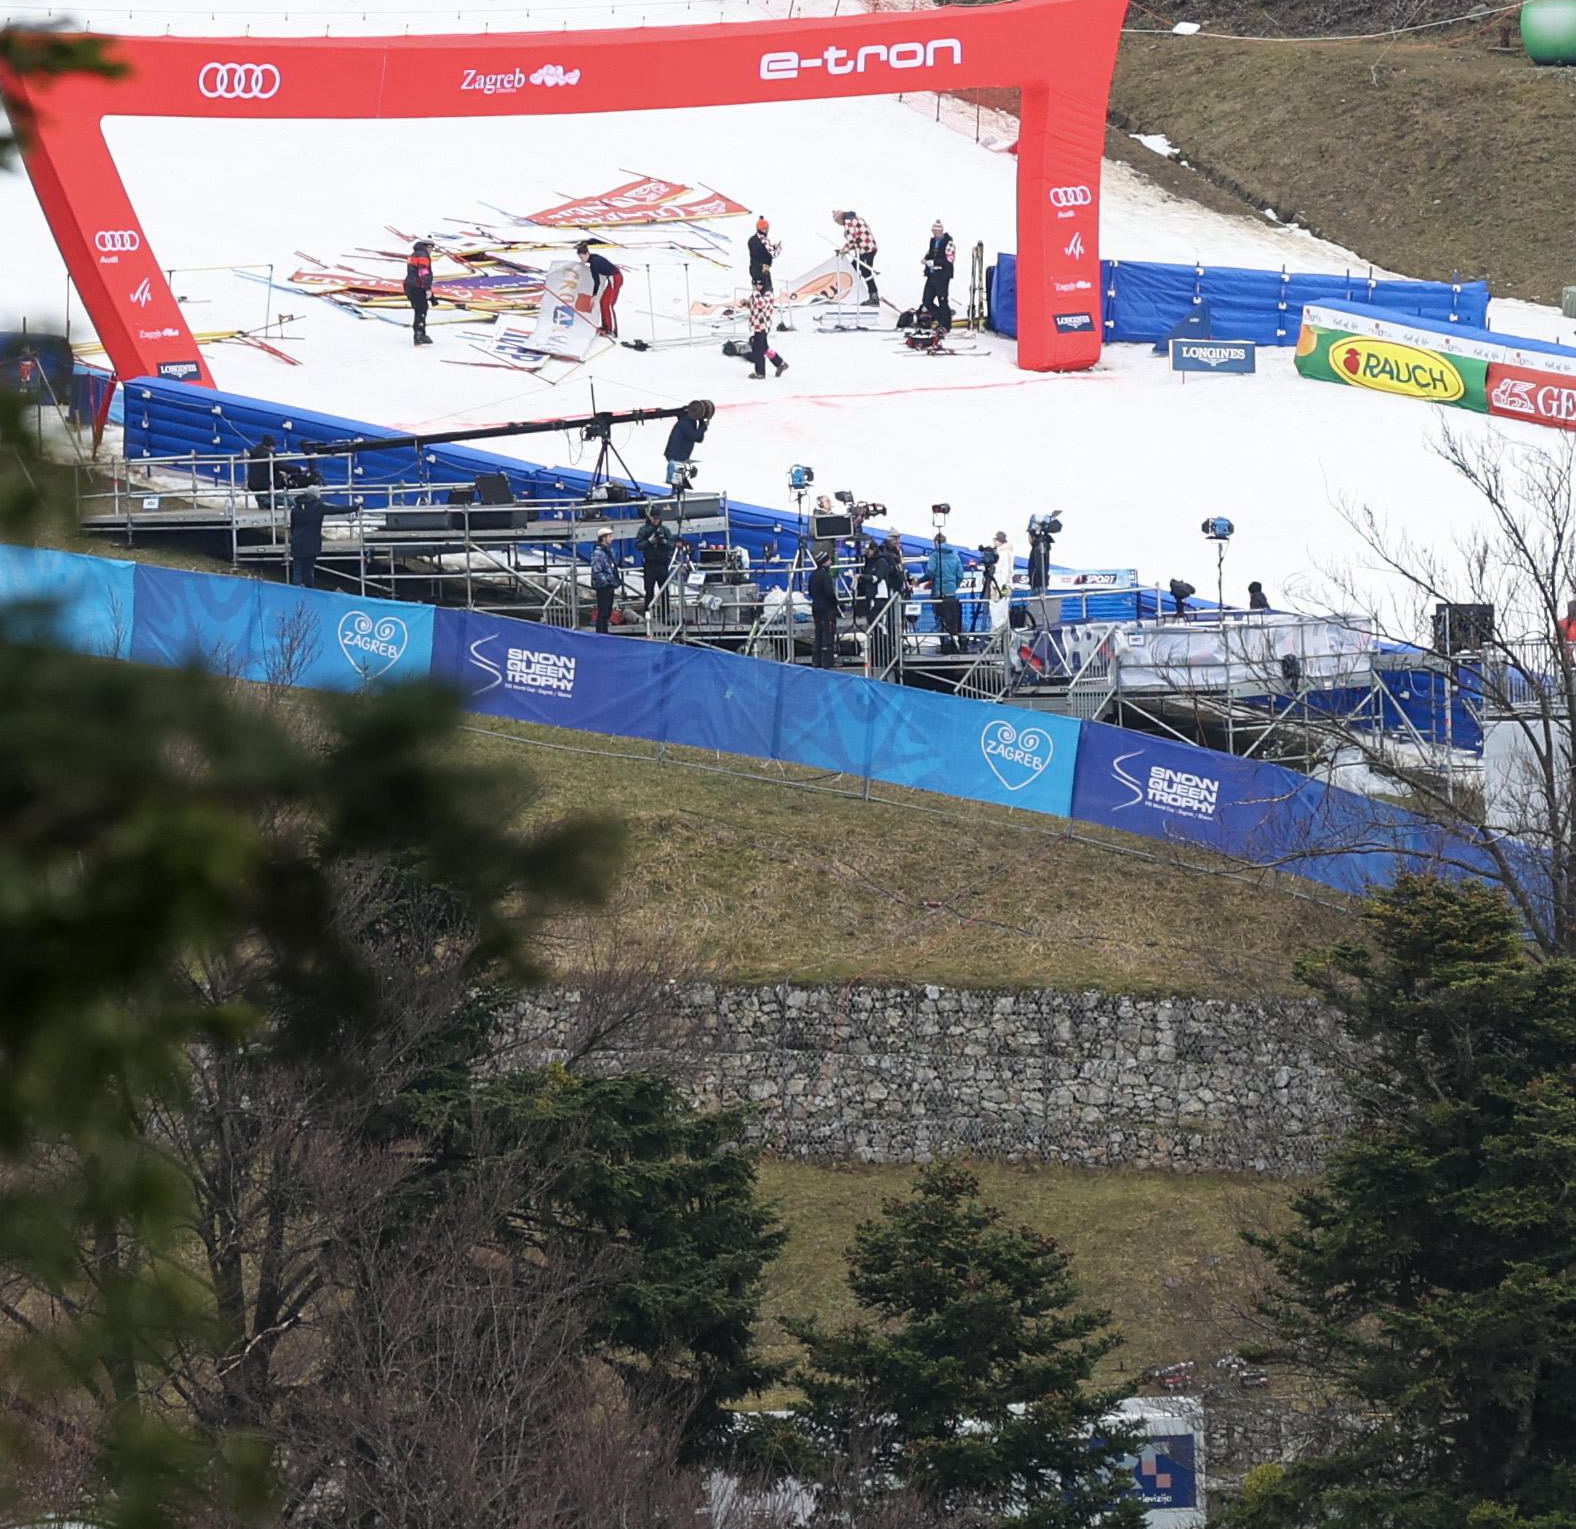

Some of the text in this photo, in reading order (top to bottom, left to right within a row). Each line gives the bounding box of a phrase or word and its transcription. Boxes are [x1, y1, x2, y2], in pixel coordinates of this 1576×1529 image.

[760, 38, 962, 80] e-tron
[460, 67, 526, 94] Zagreb
[1181, 346, 1246, 360] LONGINES
[1363, 352, 1448, 392] RAUCH
[343, 631, 398, 659] ZAGREB
[506, 660, 575, 680] QUEEN
[507, 648, 575, 668] SNOW
[506, 670, 574, 691] TROPHY
[986, 740, 1043, 770] ZAGREB
[1148, 777, 1217, 802] QUEEN
[1150, 766, 1219, 791] SNOW
[1147, 788, 1216, 814] TROPHY
[1134, 1493, 1172, 1504] levizija
